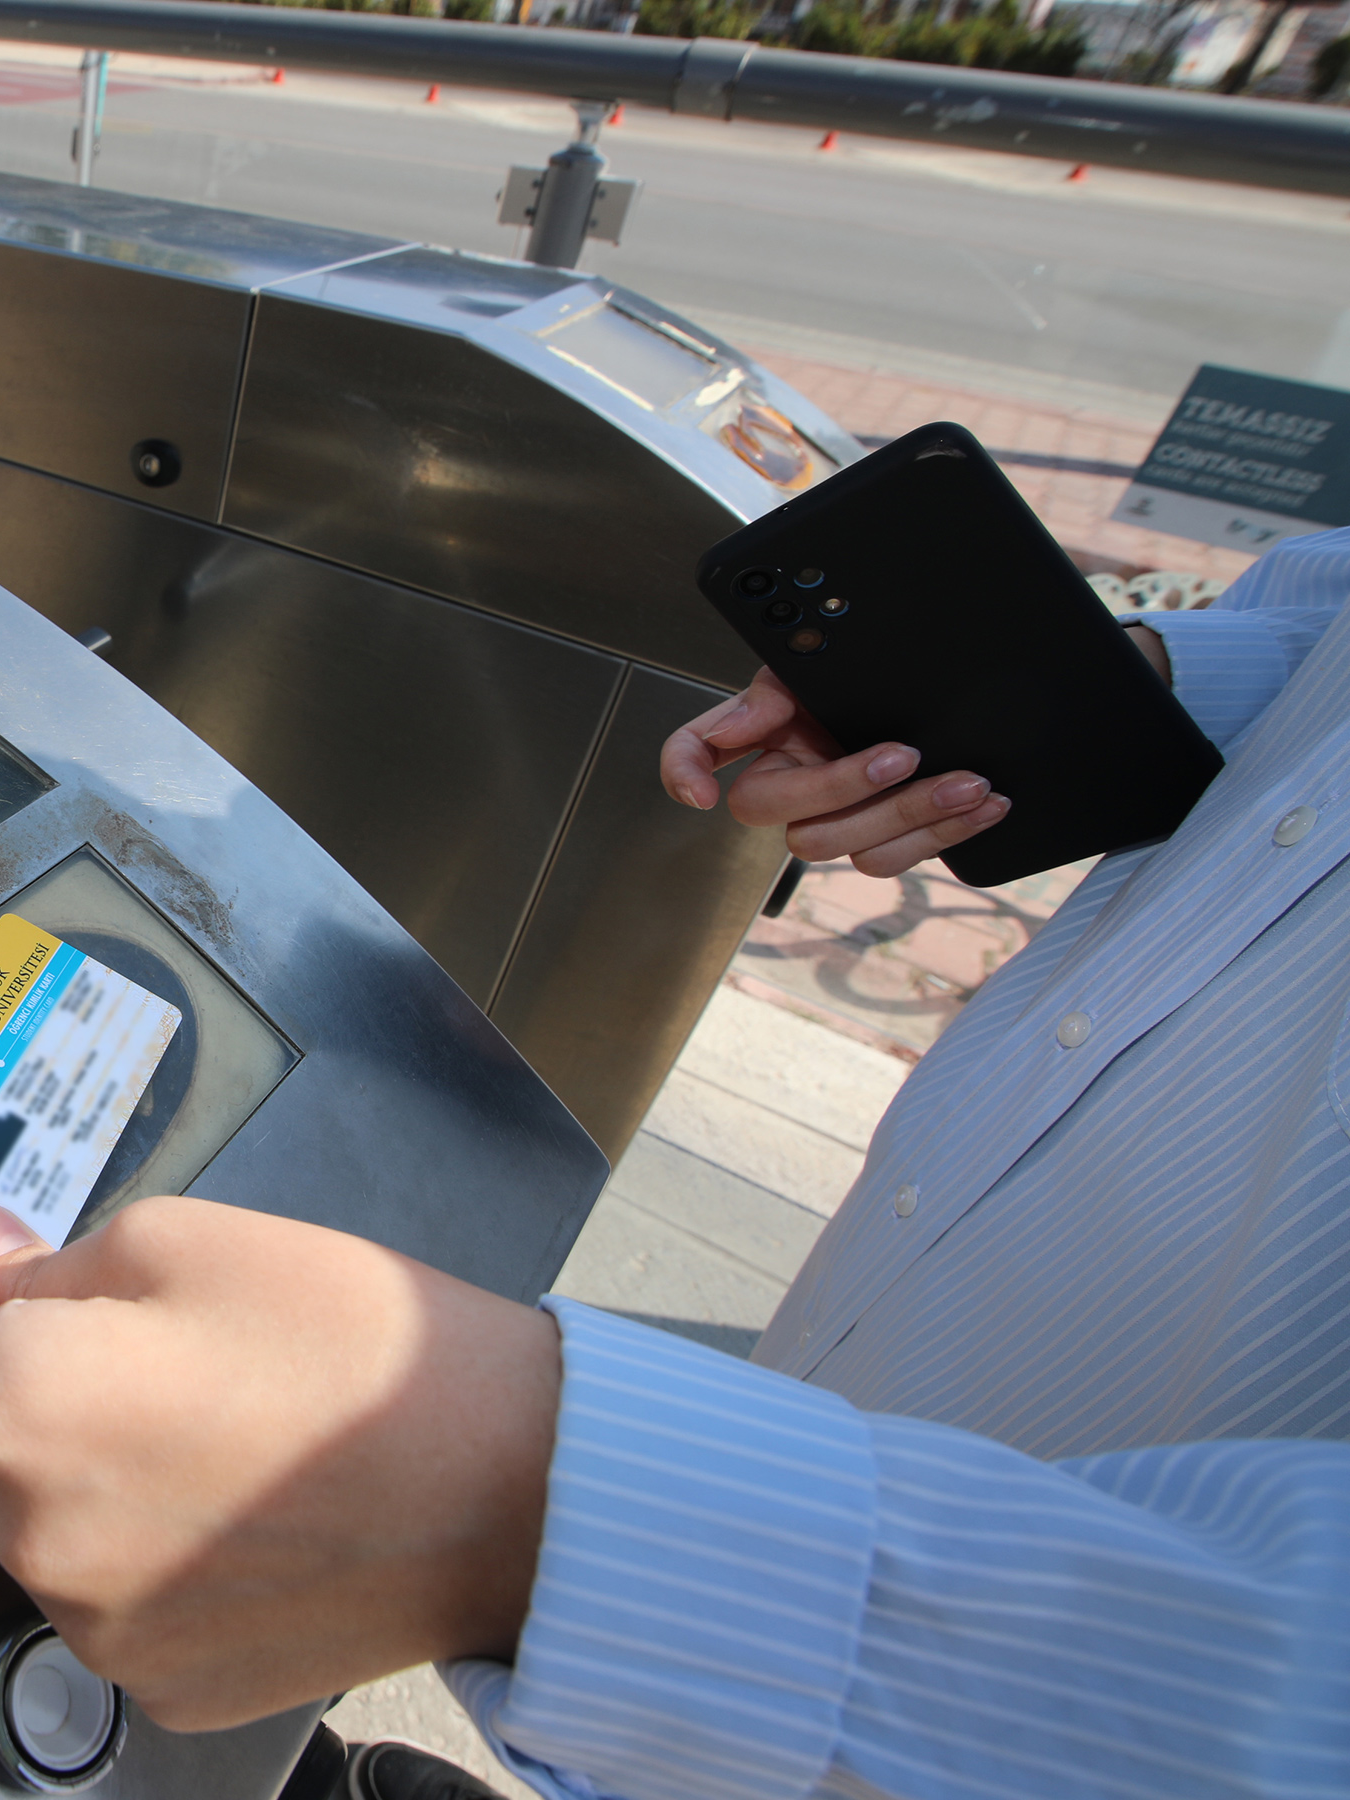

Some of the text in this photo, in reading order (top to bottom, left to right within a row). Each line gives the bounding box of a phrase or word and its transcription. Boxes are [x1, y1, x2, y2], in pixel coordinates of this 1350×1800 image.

[1182, 396, 1335, 444] TEMASSIZ
[1153, 442, 1327, 493] CONTACTLESS
[7, 1006, 31, 1035] ÖĞRENCİ
[26, 988, 45, 1010] KİMLİK
[39, 972, 56, 990] KARTI
[21, 1022, 36, 1042] STUDENT
